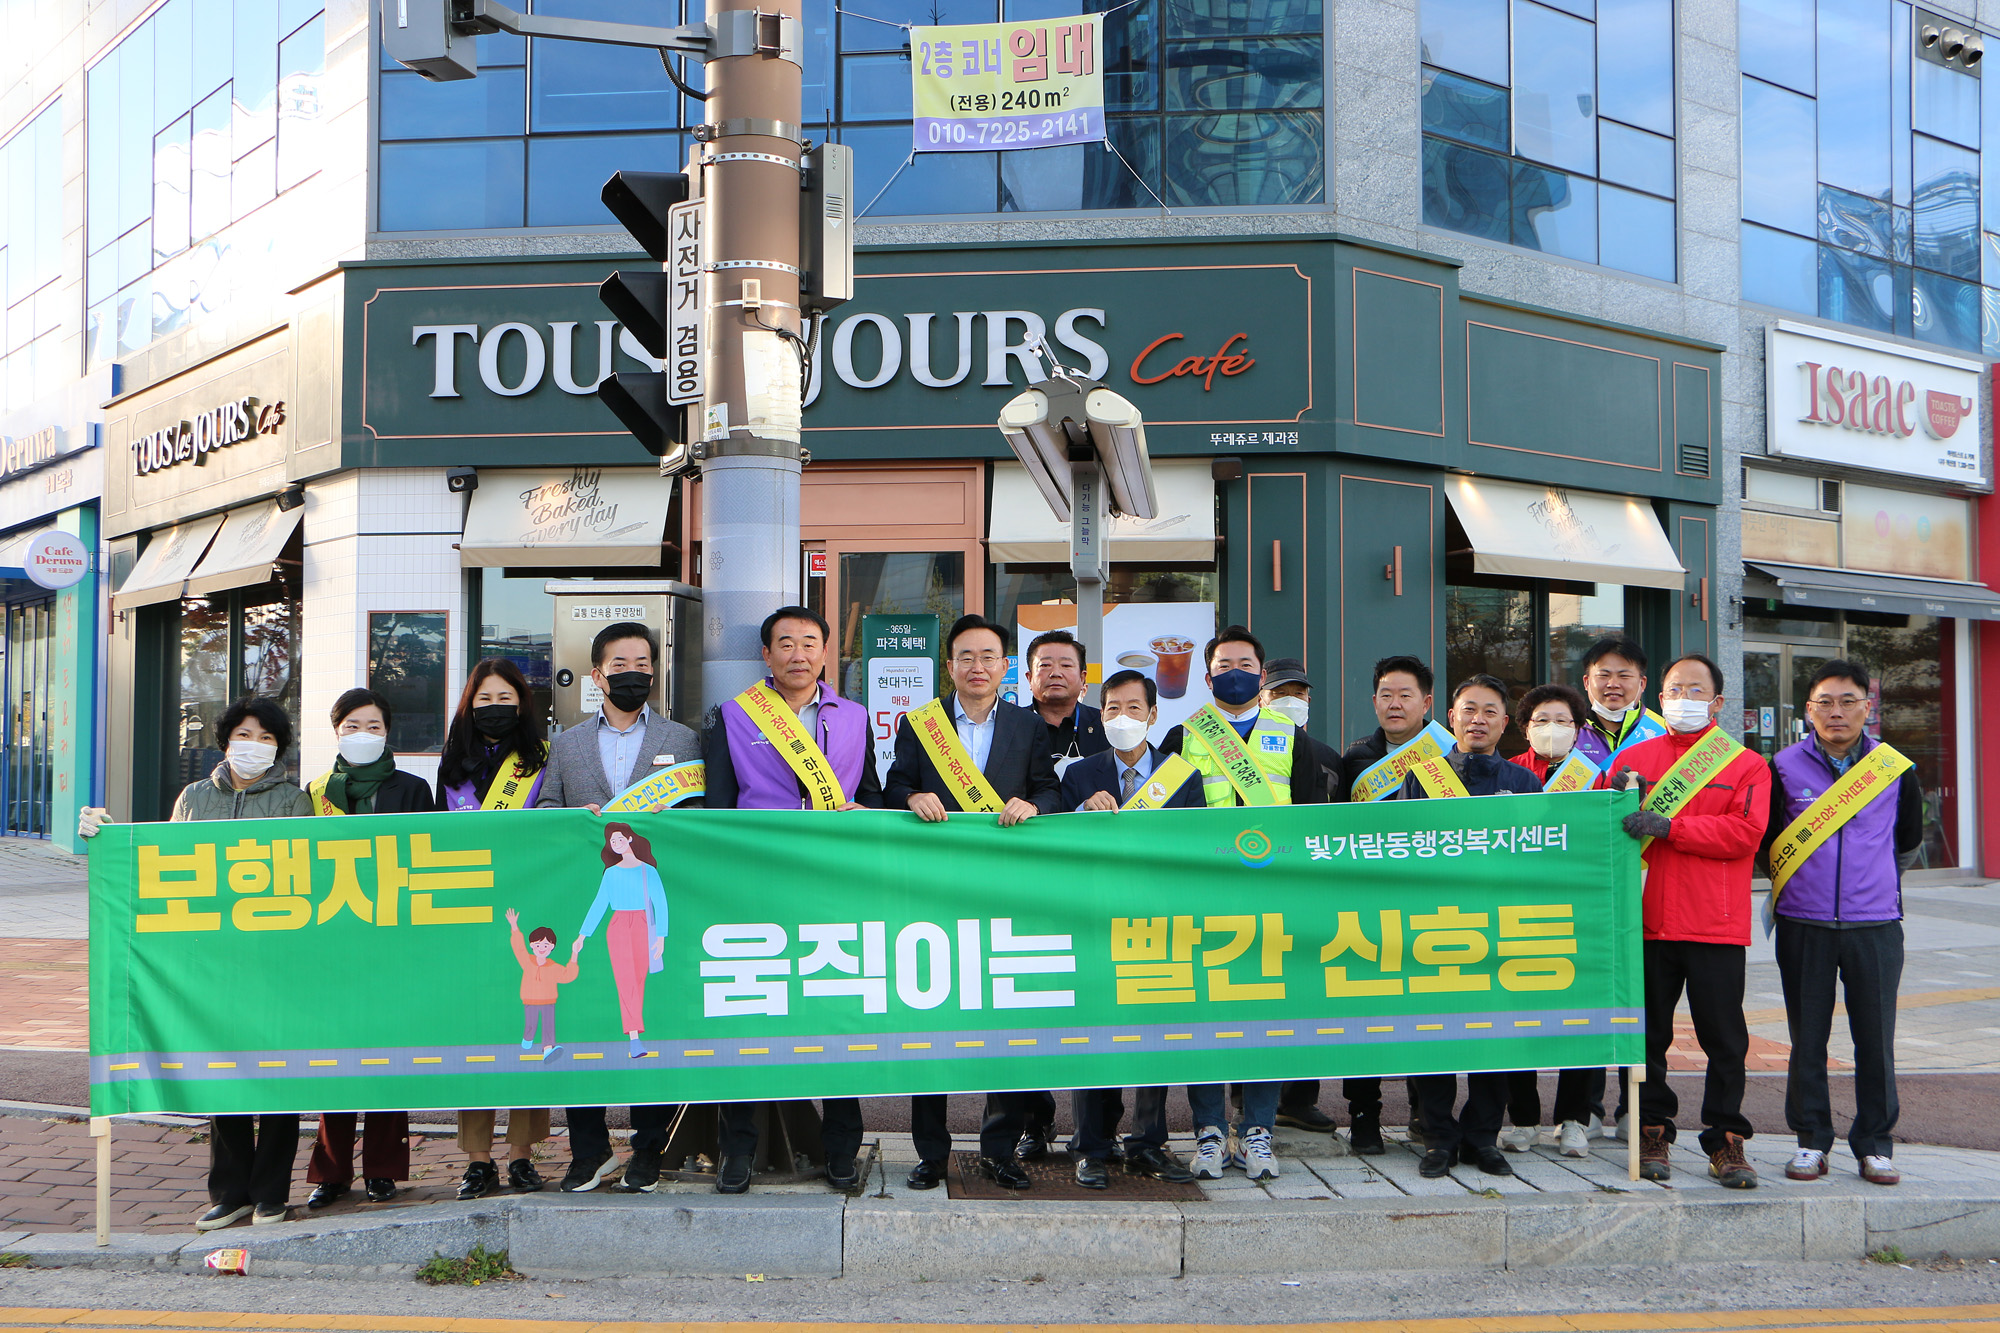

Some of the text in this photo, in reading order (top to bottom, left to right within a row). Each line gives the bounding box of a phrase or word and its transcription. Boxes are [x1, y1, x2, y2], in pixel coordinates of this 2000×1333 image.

[920, 22, 1094, 83] 2층 코너 임대
[950, 93, 996, 112] (전용)
[928, 112, 1090, 145] 010-7225-2141
[676, 209, 701, 393] 자전거 겸용
[1130, 332, 1256, 391] Café
[1799, 361, 1916, 438] Isaac
[132, 424, 175, 476] TOUS
[174, 419, 192, 462] les
[192, 395, 250, 467] JOURS
[1931, 412, 1957, 428] COFFEE
[1210, 431, 1299, 446] 뚜레쥬르 제과점
[519, 466, 603, 510] Freshly
[1081, 483, 1091, 513] 다기능
[530, 487, 605, 526] Baked,
[1081, 517, 1091, 546] 그늘막
[35, 554, 83, 566] Deruwa
[44, 545, 73, 556] Cafe
[590, 607, 611, 619] 단속용
[614, 607, 643, 619] 무인장비
[876, 636, 927, 651] 파격 혜택!
[877, 676, 924, 689] 현대카드
[891, 695, 910, 707] 매일
[1304, 823, 1568, 861] 빛가람동행정복지센터
[135, 832, 495, 933] 보행자는
[698, 903, 1578, 1018] 움직이는 빨간 신호등
